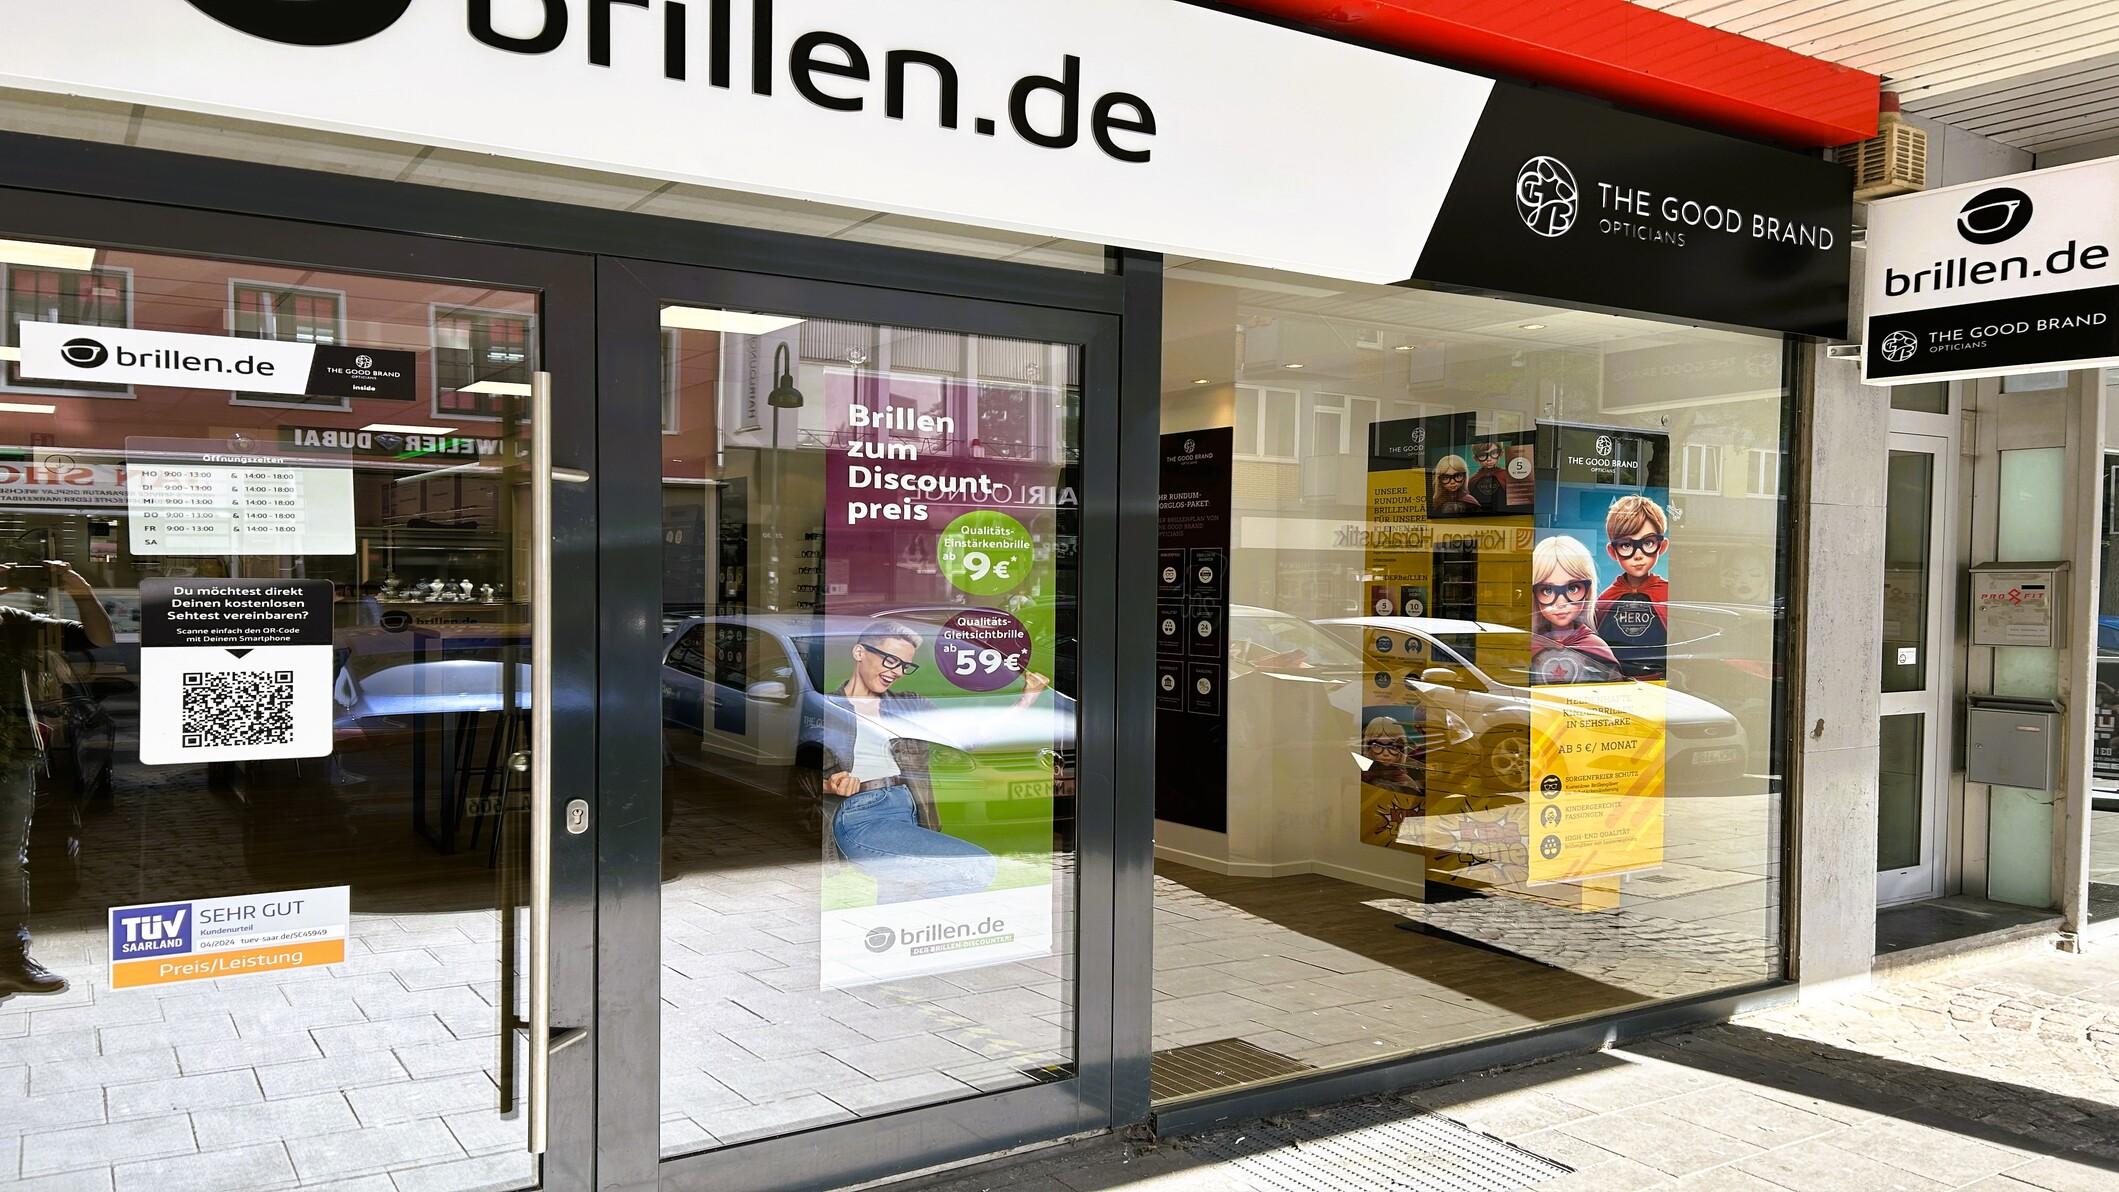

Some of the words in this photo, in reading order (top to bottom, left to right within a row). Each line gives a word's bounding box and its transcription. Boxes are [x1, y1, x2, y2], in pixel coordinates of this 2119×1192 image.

[1598, 182, 1651, 217] THE
[1661, 197, 1743, 233] GOOD
[1752, 213, 1834, 250] BRAND
[1600, 219, 1686, 247] OPTICIANS
[1885, 240, 2109, 297] brillen.de
[1928, 329, 1963, 343] THE
[1970, 321, 2029, 338] GOOD
[2036, 312, 2107, 332] BRAND
[1929, 341, 1987, 353] OPTICIANS
[117, 345, 275, 377] brillen.de
[345, 368, 371, 376] GOOD
[373, 370, 400, 378] BRAND
[849, 403, 955, 433] Brillen
[847, 440, 917, 461] zum
[1402, 444, 1424, 452] GOOD
[1516, 461, 1523, 470] 5
[1568, 456, 1584, 465] THE
[1585, 457, 1610, 467] GOOD
[1612, 460, 1638, 469] BRAND
[848, 465, 1003, 494] Discount-
[1169, 492, 1202, 500] RUNDUM-
[1375, 487, 1408, 496] UNSERE
[848, 497, 928, 525] preis
[1392, 515, 1427, 523] UNSERE
[961, 525, 1015, 536] Qualitäts-
[944, 538, 1030, 549] Einstärkenbrille
[943, 552, 956, 560] ab
[174, 587, 193, 596] Du
[198, 586, 261, 596] möchtest
[265, 587, 303, 596] direkt
[172, 599, 221, 608] Deinen
[225, 599, 305, 608] kostenlosen
[167, 612, 220, 620] Sehtest
[223, 611, 309, 620] vereinbaren?
[1619, 611, 1650, 623] HERO
[957, 616, 1011, 627] Qualitäts-
[239, 635, 291, 643] Smartphone
[944, 629, 1024, 639] Gleitsichtbrille
[943, 644, 957, 653] ab
[1567, 720, 1577, 728] IN
[1558, 745, 1573, 754] AB
[1576, 743, 1582, 752] 5
[1601, 740, 1638, 751] MONAT
[1565, 773, 1614, 782] SORGENFREIER
[200, 905, 256, 924] SEHR
[262, 900, 305, 918] GUT
[121, 909, 187, 942] TÜV
[200, 924, 254, 936] Kundenurteil
[901, 917, 1005, 945] brillen.de
[122, 937, 183, 953] SAARLAND
[200, 938, 235, 949] 04/2024
[159, 951, 304, 978] Preis/Leistung
